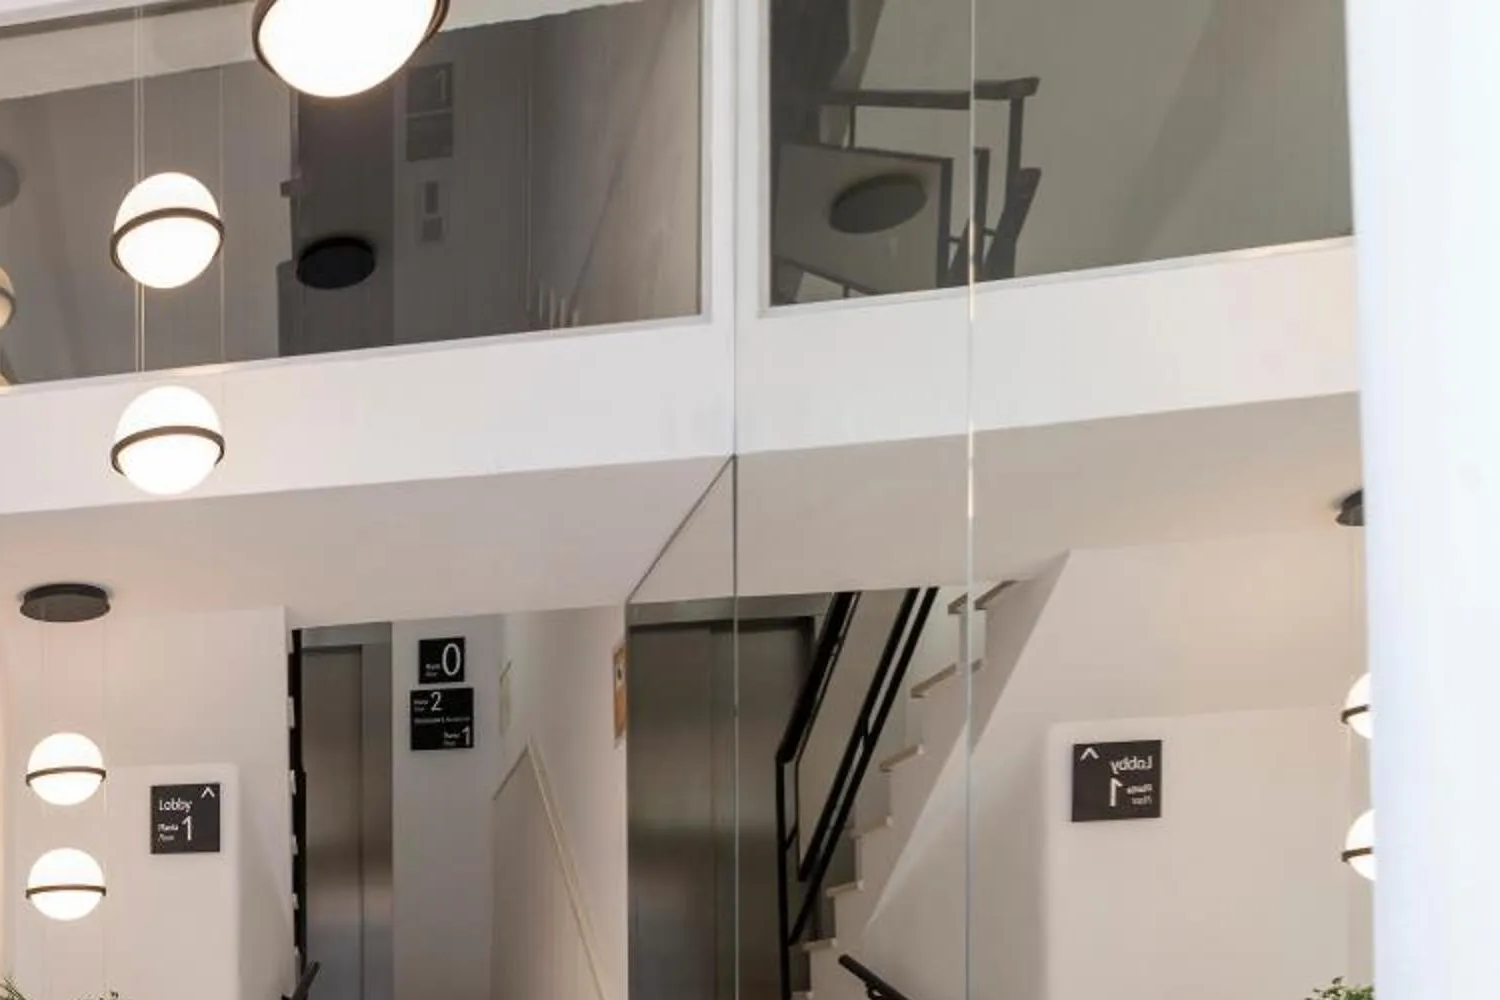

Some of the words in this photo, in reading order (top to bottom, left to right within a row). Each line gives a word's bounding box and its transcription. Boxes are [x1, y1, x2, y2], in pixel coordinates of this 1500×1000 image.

[443, 643, 461, 676] 0
[430, 691, 443, 712] 2
[461, 726, 470, 746] 1
[158, 797, 193, 813] Lobby
[181, 815, 192, 841] 1
